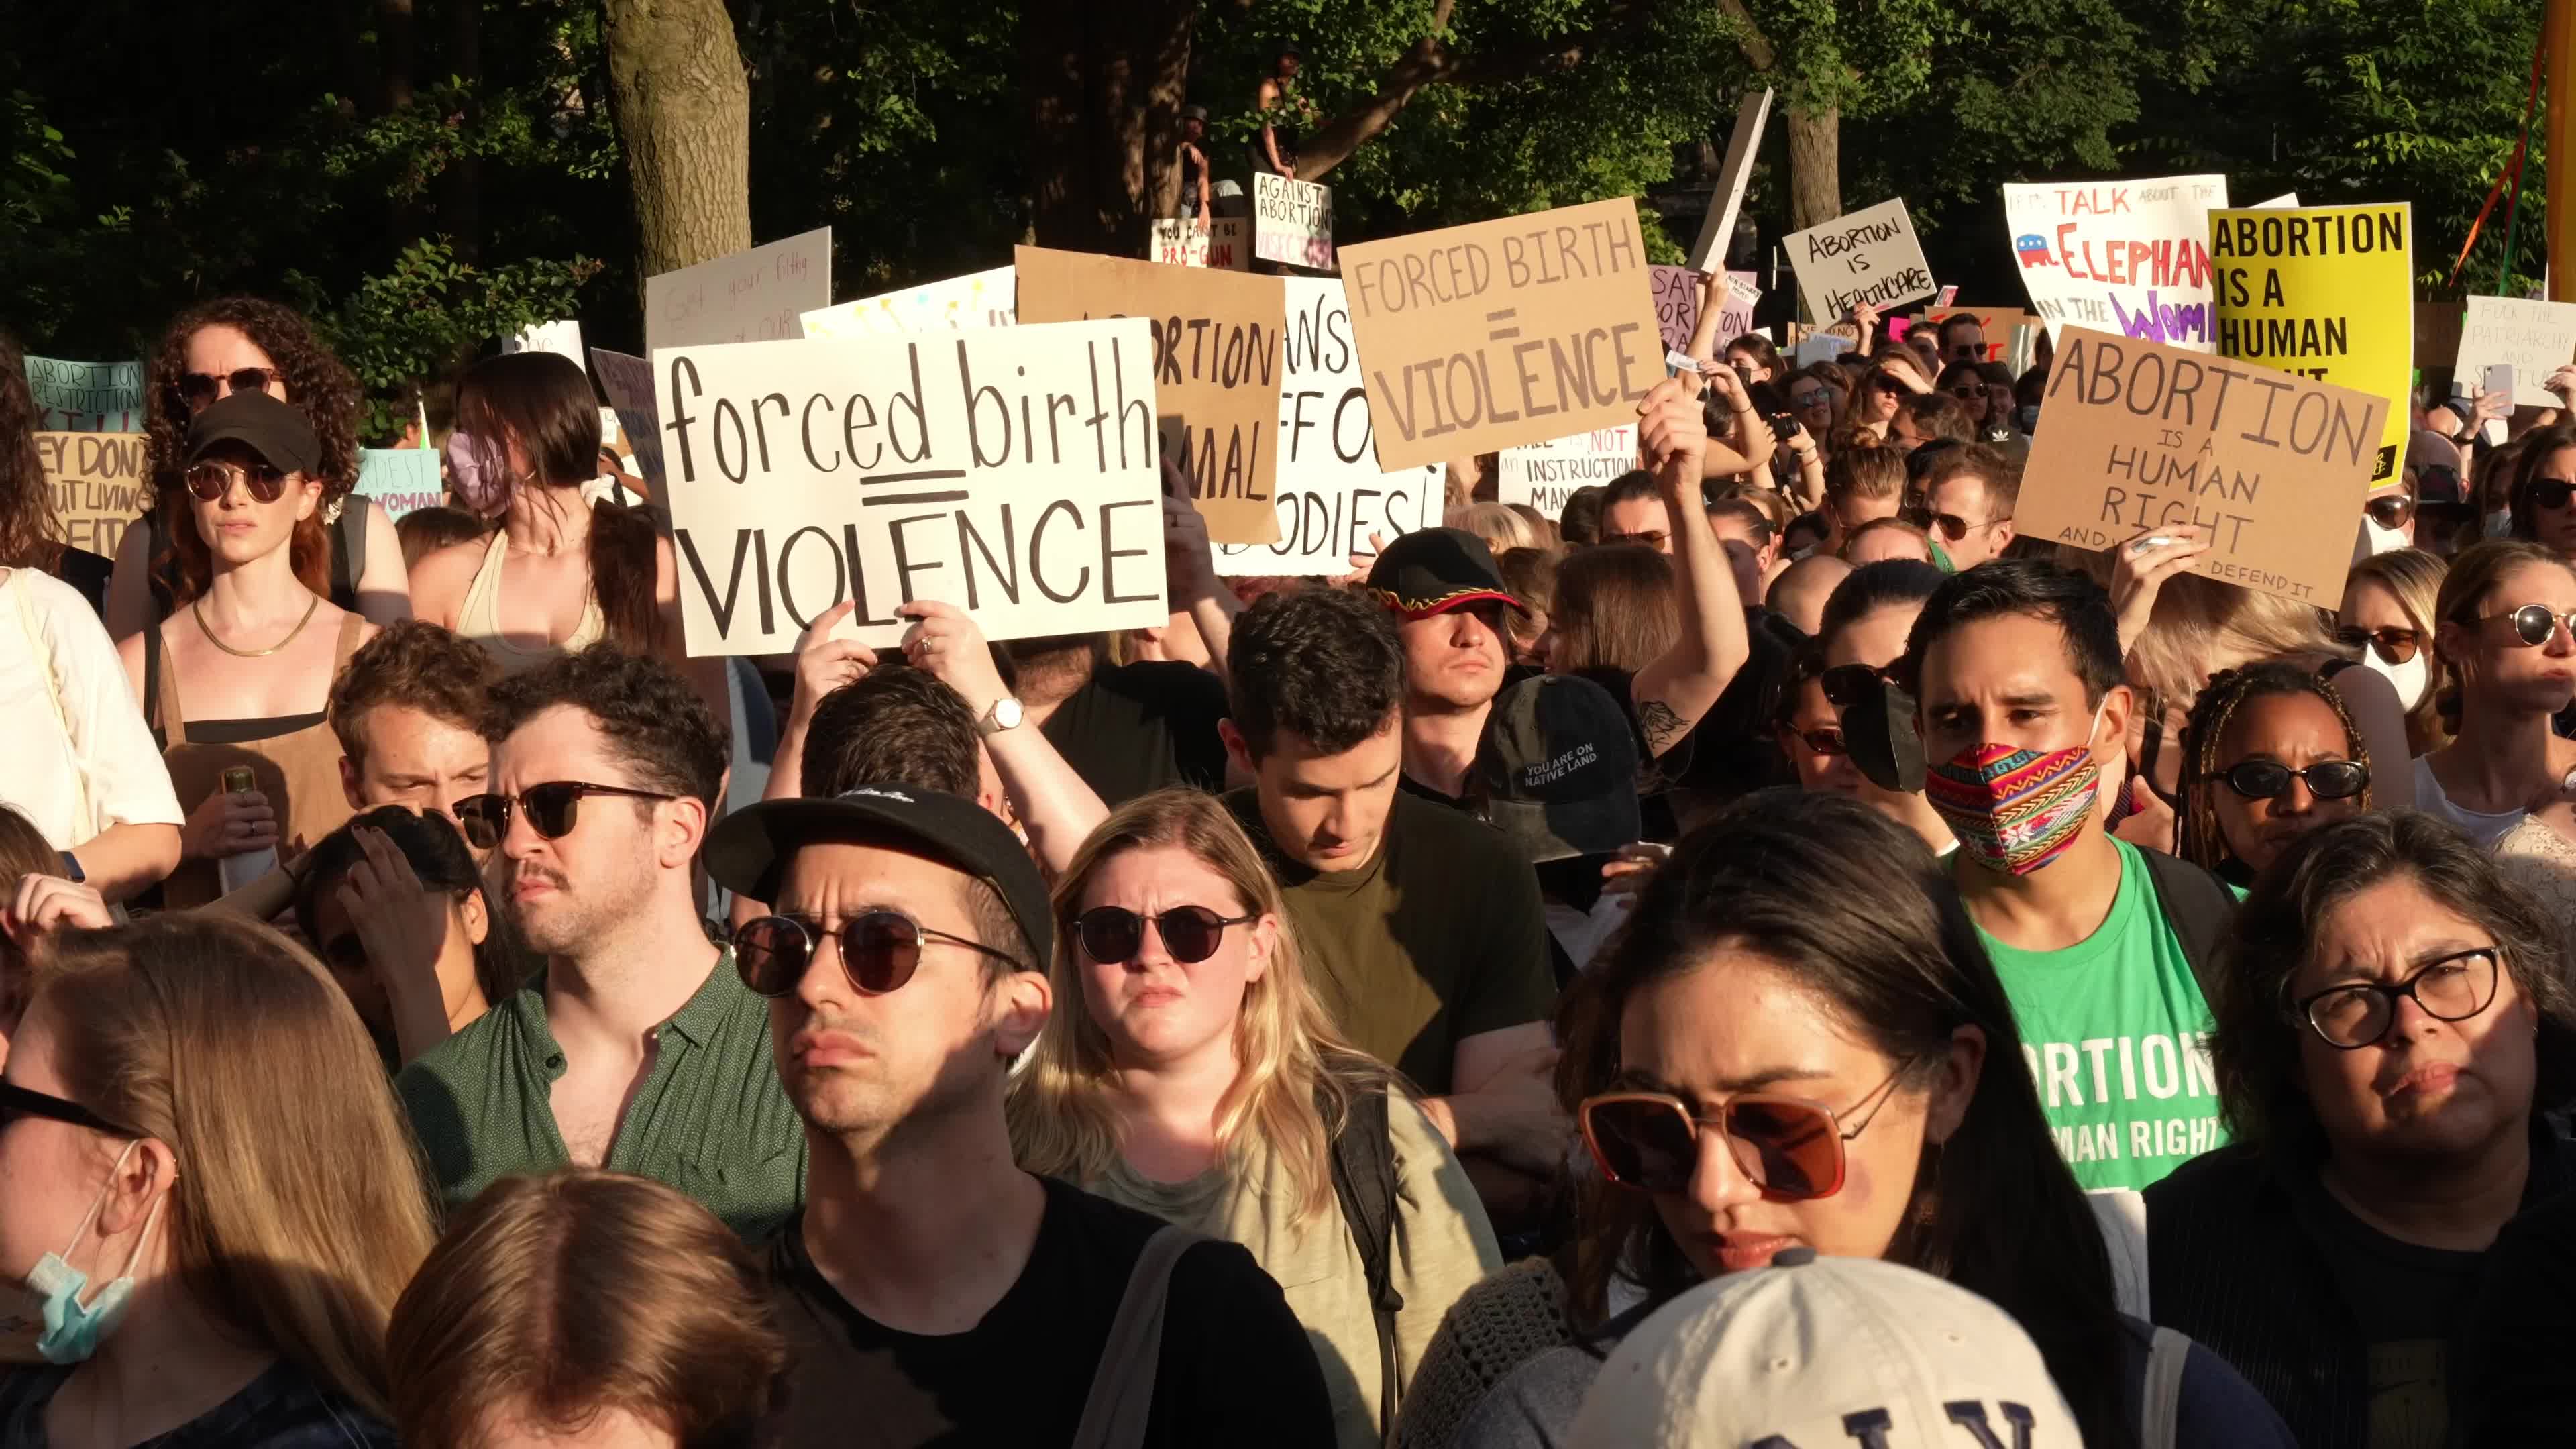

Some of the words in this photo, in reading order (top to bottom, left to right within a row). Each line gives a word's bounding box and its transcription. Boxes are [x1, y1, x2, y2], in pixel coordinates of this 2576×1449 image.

[1259, 176, 1322, 204] AGAINST
[2054, 188, 2131, 215] TALK
[2139, 186, 2179, 202] ABOUT
[1159, 226, 1180, 240] YOU
[1260, 198, 1331, 231] ABORTION
[1808, 217, 1901, 263] ABORTION
[2214, 212, 2402, 257] ABORTION
[1163, 244, 1232, 266] PRO-GUN
[1354, 243, 1490, 317] FORCED
[1503, 218, 1636, 289] BIRTH
[1846, 254, 1870, 274] IS
[2057, 223, 2213, 289] ELEPHAN
[1825, 268, 1931, 320] HEALTHCARE
[2218, 268, 2249, 307] IS
[2263, 268, 2285, 307] A
[2035, 299, 2066, 320] IN
[2068, 297, 2108, 323] THE
[2221, 317, 2347, 358] HUMAN
[2472, 326, 2569, 351] PATRIARCHY
[32, 359, 140, 388] ABORTION
[1374, 322, 1650, 442] VIOLENCE
[666, 343, 932, 484] forced
[957, 337, 1152, 474] birth
[2048, 339, 2373, 466] ABORTION
[34, 436, 69, 474] EY
[1591, 429, 1629, 451] NOT
[2157, 429, 2183, 449] IS
[2198, 437, 2214, 457] A
[1526, 456, 1635, 482] INSTRUCTION
[2107, 445, 2261, 504] HUMAN
[365, 492, 441, 511] WOMAN
[1218, 476, 1427, 557] ODIES!
[2100, 487, 2255, 554] RIGHT
[674, 499, 1160, 640] VIOLENCE
[2059, 526, 2107, 547] AND
[2211, 561, 2288, 590] DEFEND
[2290, 583, 2314, 599] IT
[1525, 767, 1565, 787] NATIVE
[1568, 753, 1597, 772] LAND
[1527, 761, 1550, 777] YOU
[1552, 751, 1574, 769] ARE
[1577, 743, 1594, 756] ON
[2052, 1122, 2119, 1163] MAN
